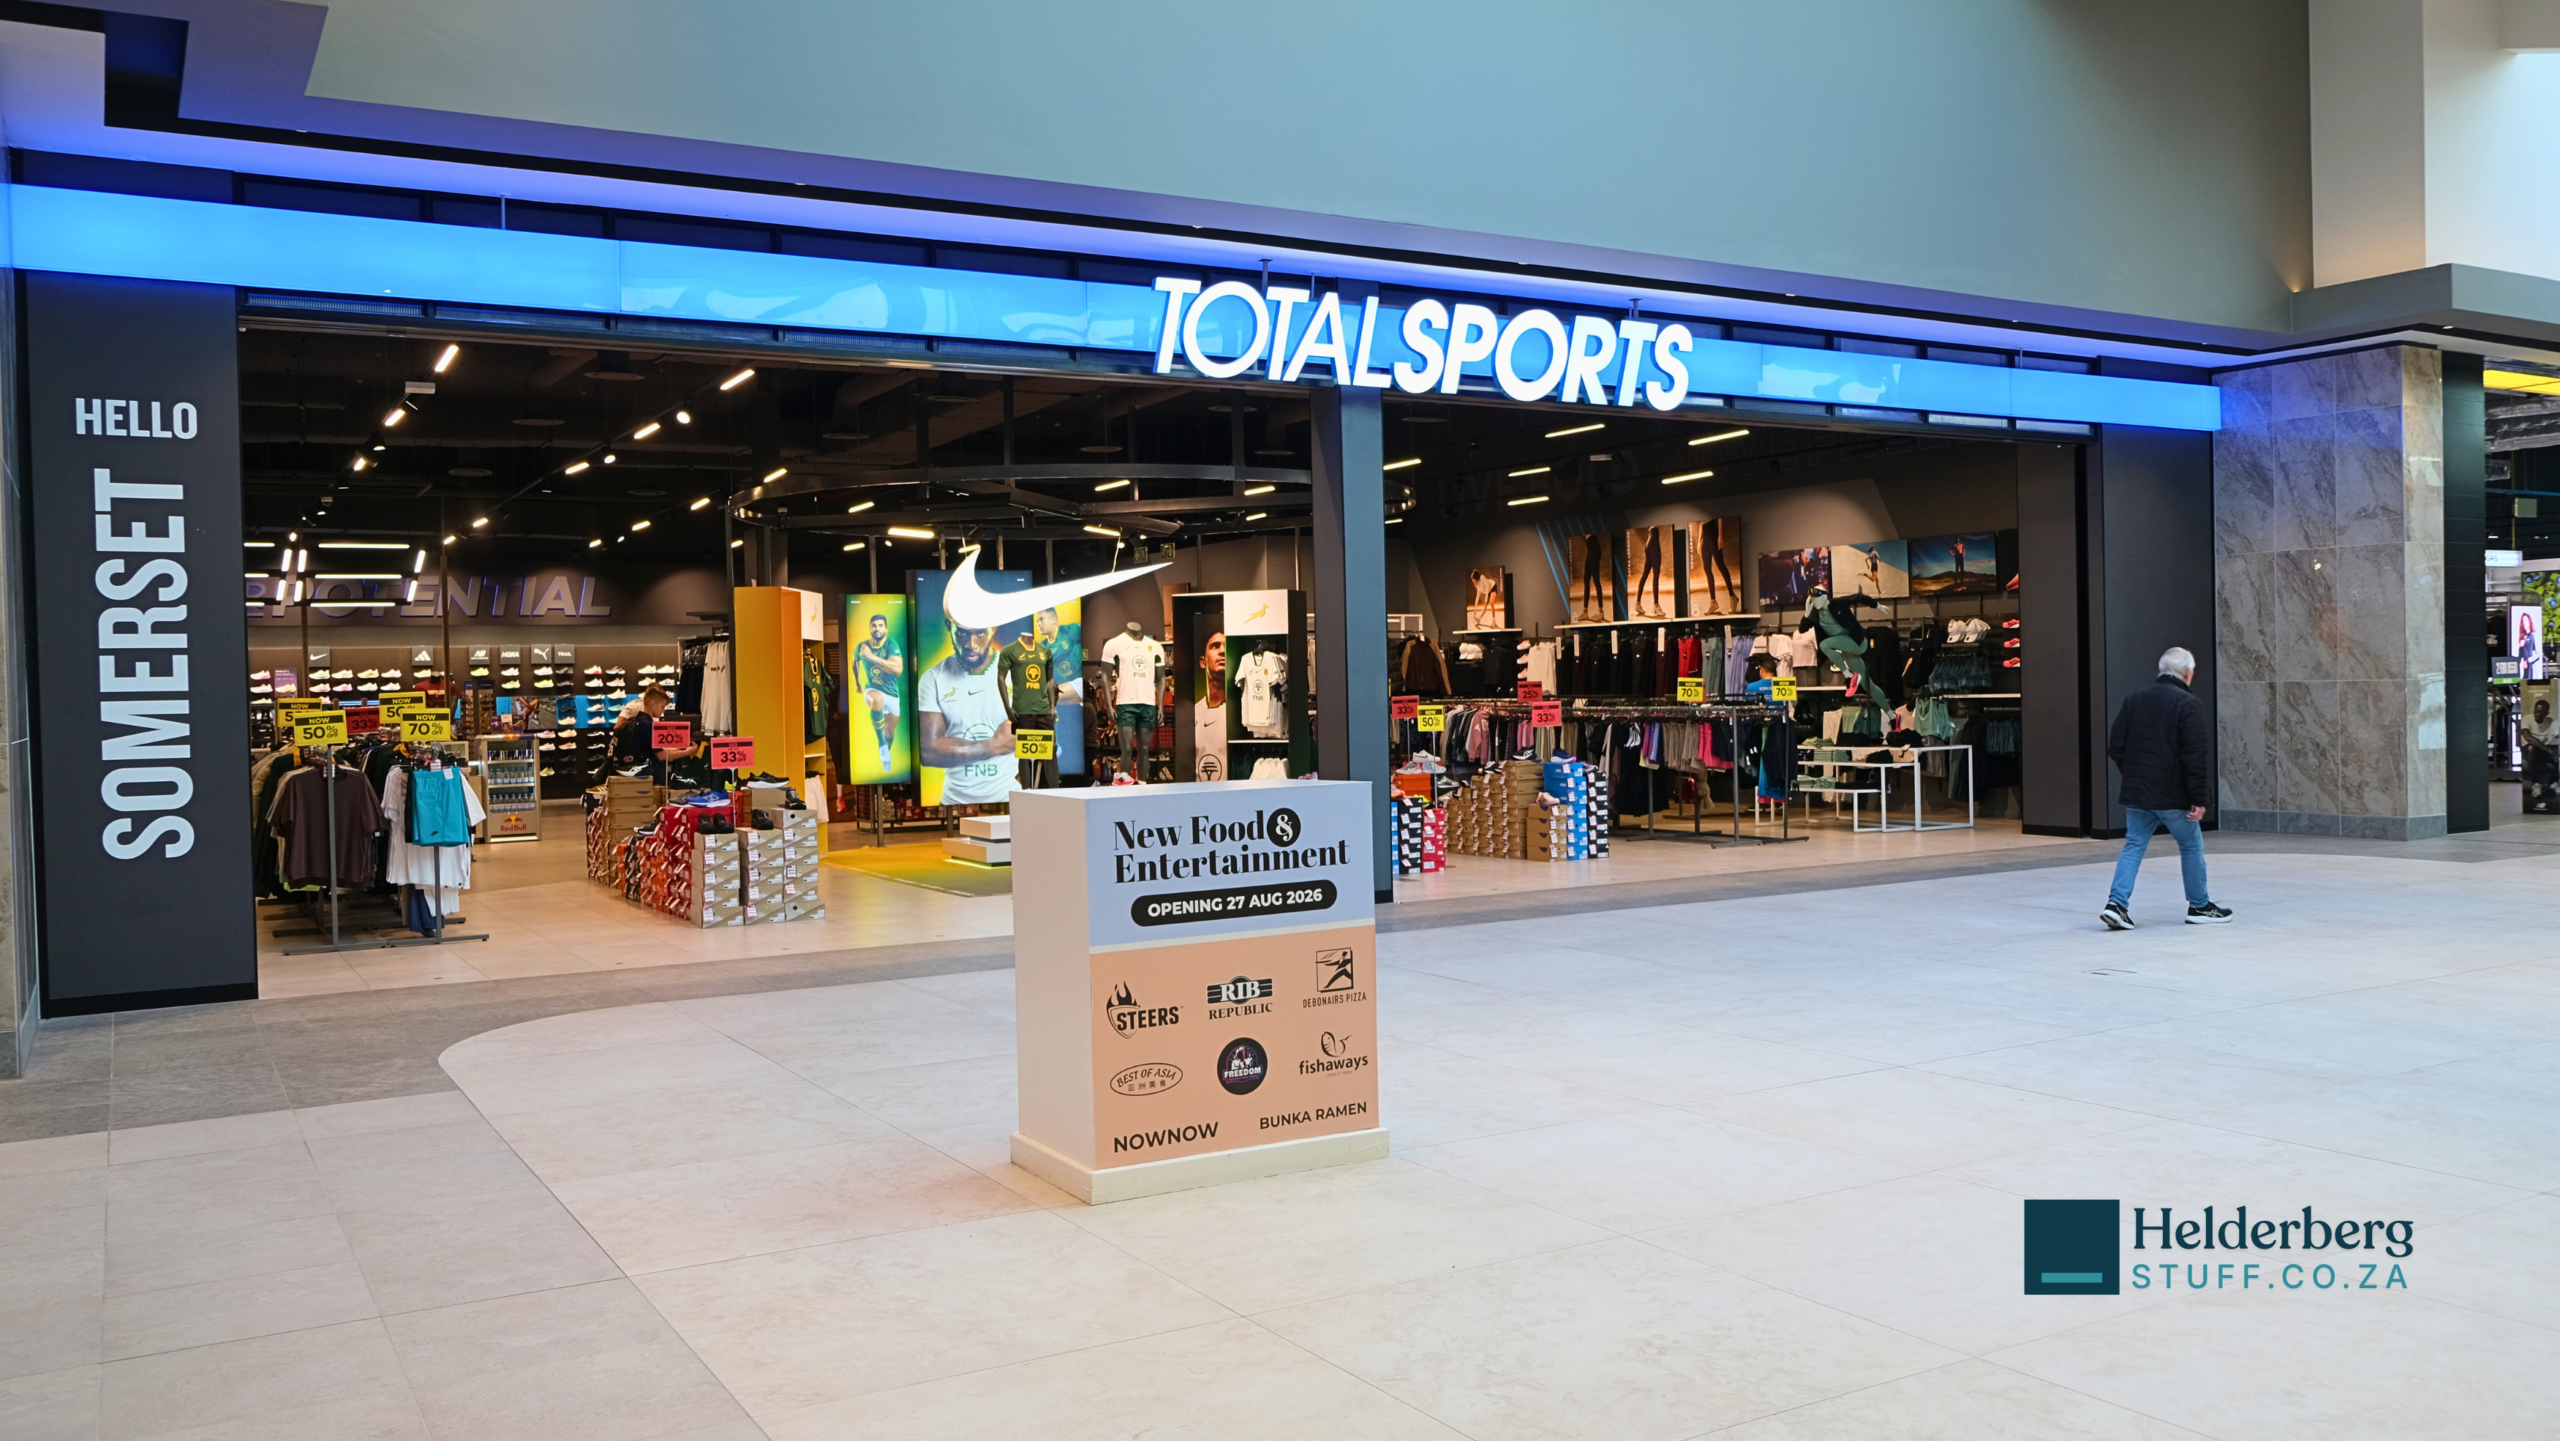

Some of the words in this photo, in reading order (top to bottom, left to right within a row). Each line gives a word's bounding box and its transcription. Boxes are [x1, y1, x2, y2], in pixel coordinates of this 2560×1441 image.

[1151, 276, 1693, 411] TOTALSPORTS
[75, 397, 198, 440] HELLO
[271, 575, 611, 617] POTENTIAL
[93, 468, 195, 860] SOMERSET
[309, 717, 330, 725] NOW
[964, 764, 998, 777] FNB
[500, 824, 514, 832] Red
[1113, 820, 1182, 850] New
[1190, 810, 1265, 845] Food
[1275, 814, 1293, 842] &
[1114, 839, 1350, 884] Entertainment
[1147, 898, 1223, 917] OPENING
[1226, 895, 1245, 911] 27
[1249, 892, 1283, 908] AUG
[1286, 888, 1323, 905] 2026
[1219, 980, 1261, 1002] RIB
[1303, 994, 1344, 1009] DEBONAIRS
[1346, 992, 1367, 1003] PIZZA
[1117, 1006, 1179, 1031] STEERS
[1208, 1002, 1273, 1020] REPUBLIC
[1224, 1066, 1262, 1079] FREEDOM
[1299, 1055, 1368, 1075] fishaways
[1116, 1070, 1139, 1088] BEST
[1140, 1068, 1153, 1079] OF
[1154, 1068, 1177, 1081] ASIA
[1259, 1110, 1312, 1130] BUNKA
[1315, 1101, 1367, 1121] RAMEN
[1113, 1121, 1219, 1153] NOWNOW
